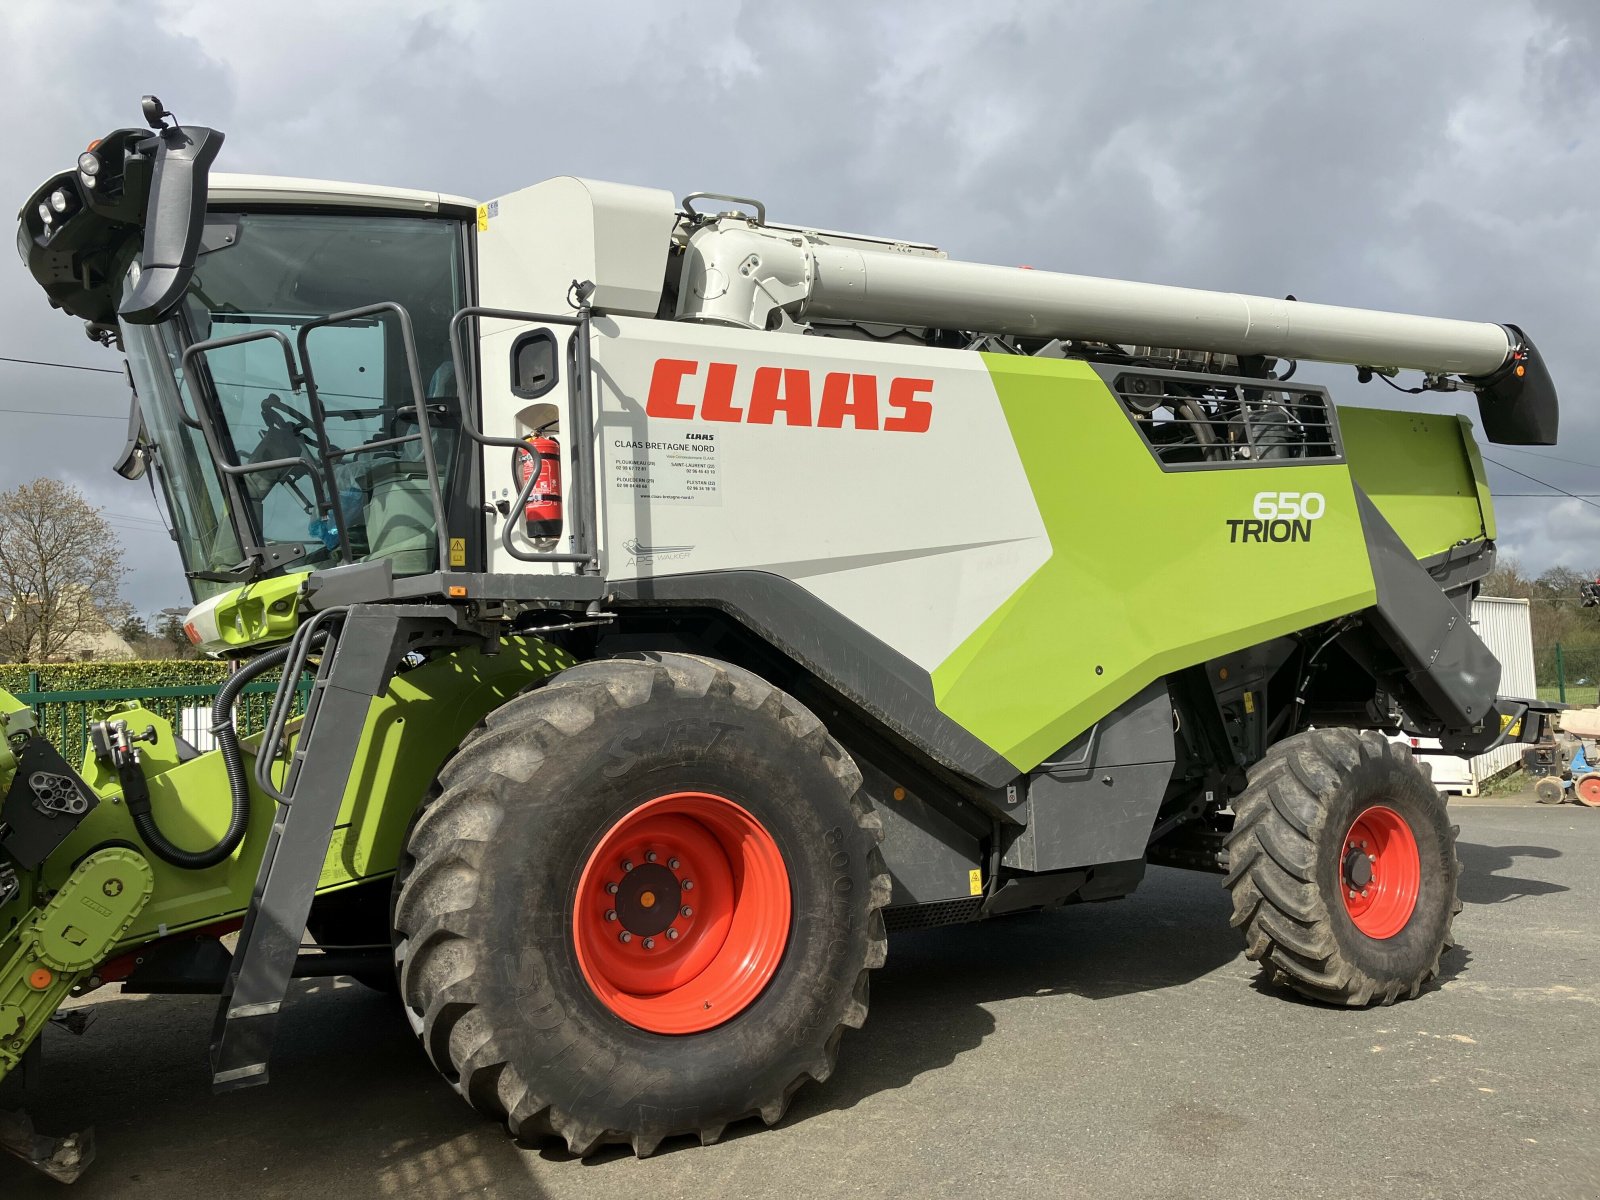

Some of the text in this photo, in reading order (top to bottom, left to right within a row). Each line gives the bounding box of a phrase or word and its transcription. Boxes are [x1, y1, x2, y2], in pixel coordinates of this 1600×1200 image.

[646, 358, 934, 433] CLAAS
[686, 433, 714, 441] CLAAS
[614, 440, 715, 452] CLAAS BRETAGNE NORD
[1253, 492, 1325, 520] 650
[1226, 520, 1312, 543] TRION
[626, 556, 653, 567] APS
